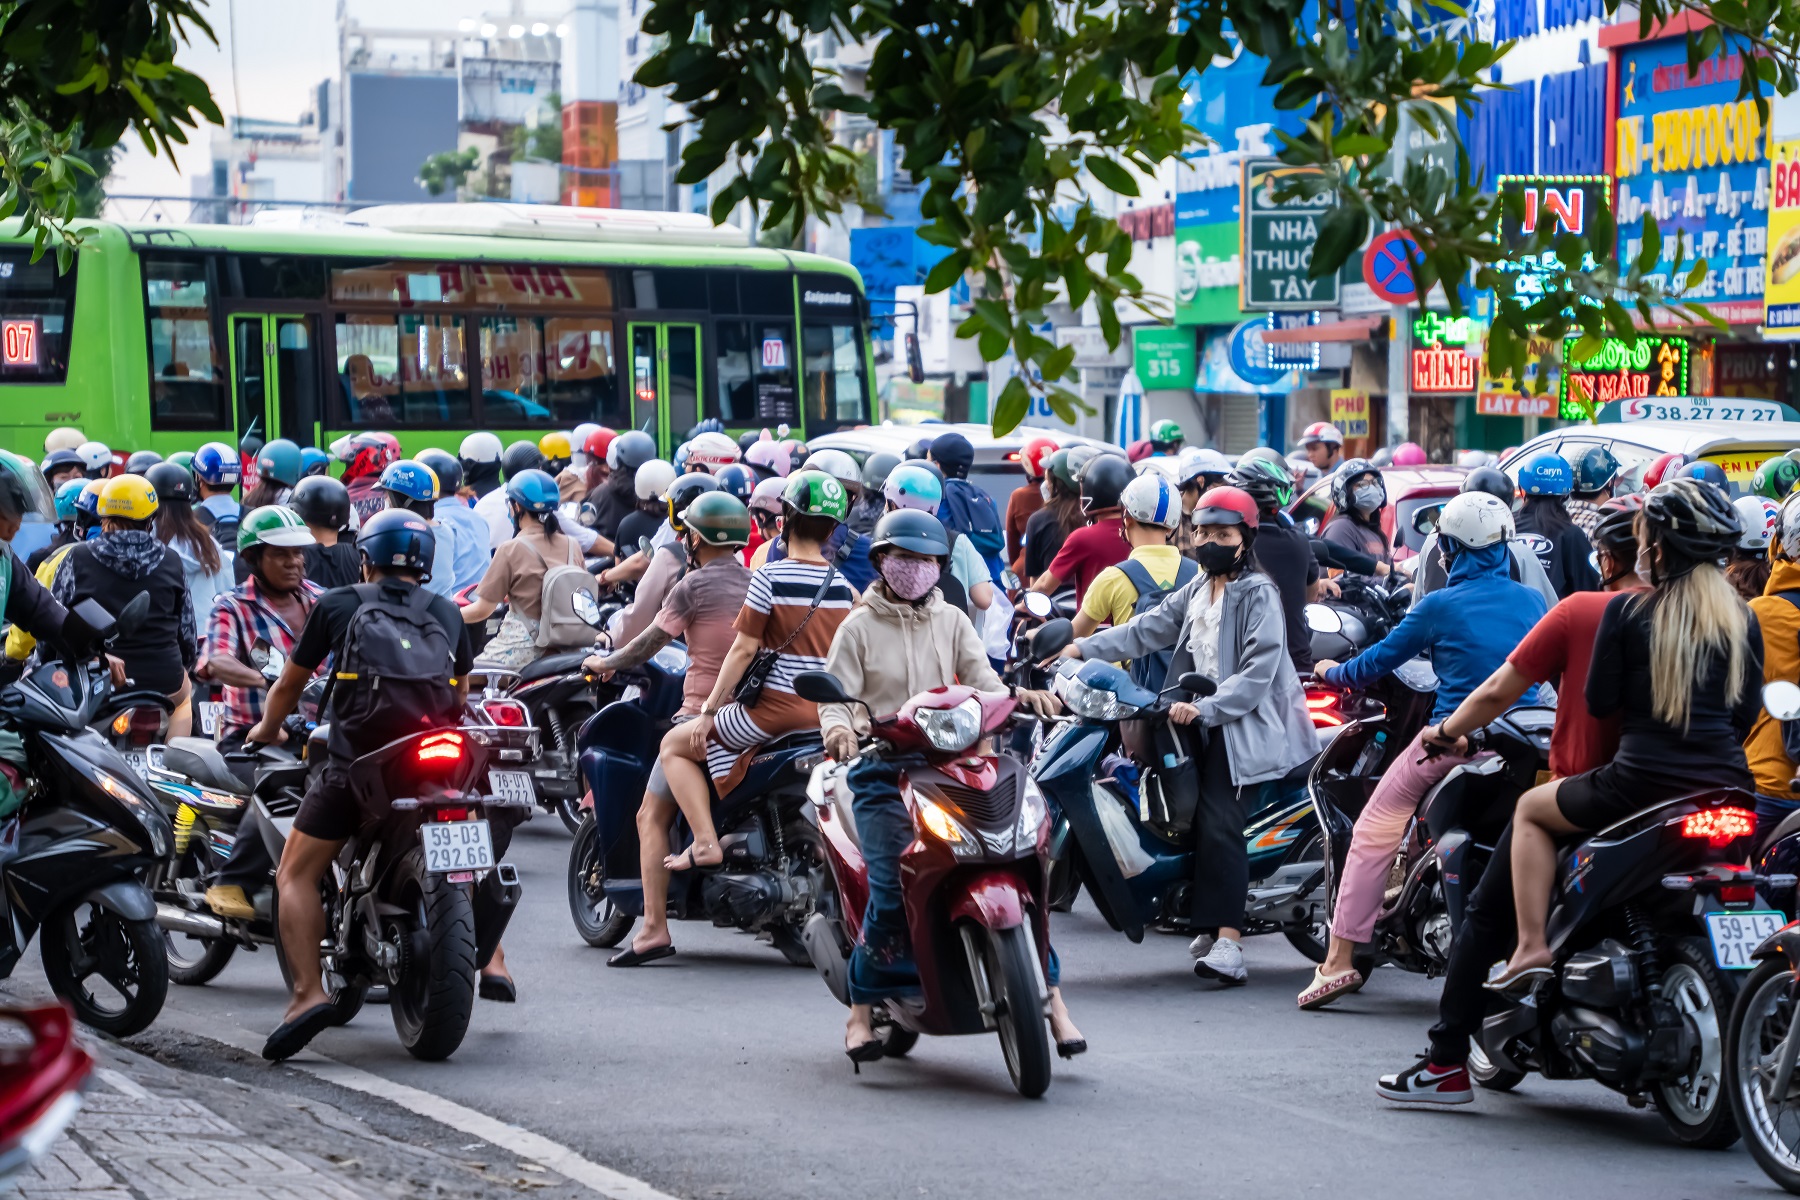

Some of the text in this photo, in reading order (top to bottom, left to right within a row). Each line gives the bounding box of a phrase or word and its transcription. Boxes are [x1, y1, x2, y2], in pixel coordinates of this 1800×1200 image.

[1523, 188, 1583, 235] IN
[1269, 215, 1318, 241] NHÀ
[1253, 242, 1316, 271] THUỐ
[1270, 275, 1317, 299] TÂY
[4, 323, 34, 362] 07
[763, 341, 782, 365] 07
[1148, 359, 1180, 378] 315
[1720, 408, 1745, 421] 27
[1751, 409, 1776, 421] 27
[1536, 466, 1562, 477] Caryn
[1722, 458, 1741, 474] ÈN
[431, 825, 480, 847] 59-D3
[429, 846, 488, 869] 292.66
[1718, 916, 1776, 940] 59-L3
